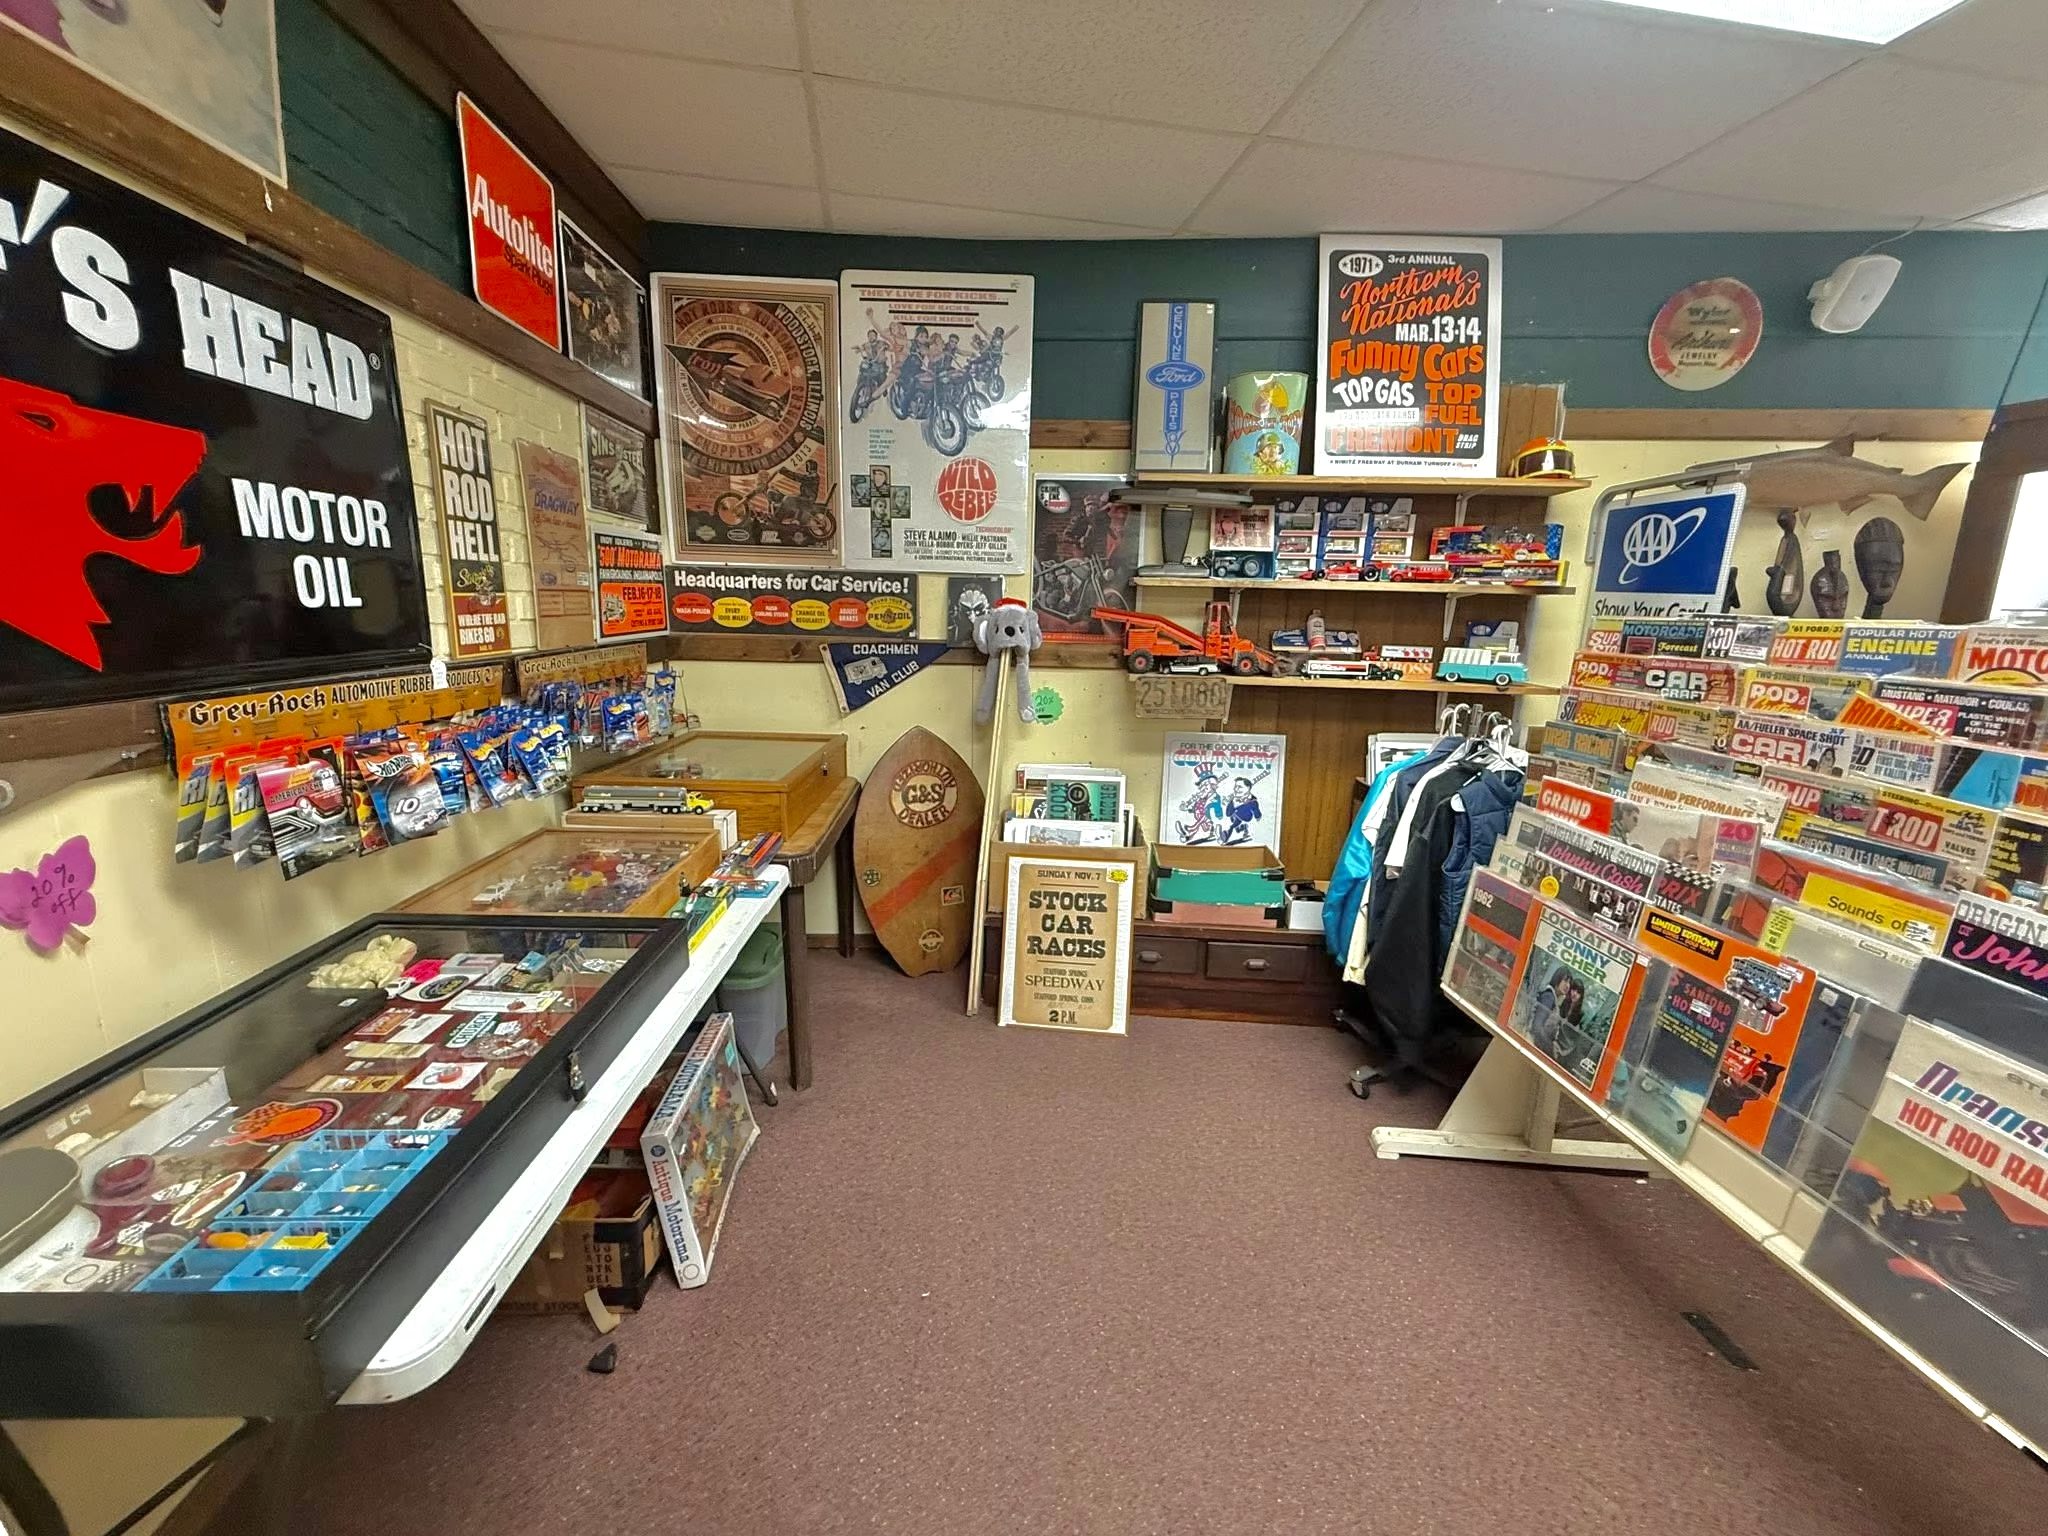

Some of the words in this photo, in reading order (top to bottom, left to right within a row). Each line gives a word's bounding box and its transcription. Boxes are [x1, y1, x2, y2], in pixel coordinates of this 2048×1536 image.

[472, 173, 553, 279] Autolite
[1349, 258, 1374, 273] 1971
[1388, 254, 1406, 264] 3rd
[1407, 254, 1456, 265] ANNUAL
[860, 289, 893, 297] THEY
[896, 290, 925, 298] LIVE
[927, 291, 952, 299] FOR
[1340, 265, 1479, 306] Northern
[1341, 281, 1481, 336] Nationals
[1171, 305, 1183, 361] GENUINE
[1396, 323, 1432, 342] MAR.
[1330, 338, 1420, 381] Funny
[1423, 342, 1484, 381] Cars
[1155, 366, 1197, 383] Ford
[1333, 376, 1374, 407] TOP
[1374, 379, 1415, 407] GAS
[1425, 383, 1482, 403] TOP
[800, 380, 824, 431] ILLINOIS
[1168, 392, 1178, 430] PARTS
[1424, 405, 1482, 426] FUEL
[435, 415, 486, 475] HOT
[1330, 426, 1459, 454] FREMONT
[790, 444, 813, 466] 2013
[939, 459, 997, 490] WILD
[442, 470, 494, 522] ROD
[938, 489, 998, 521] REBELS
[231, 478, 391, 550] MOTOR
[447, 519, 499, 562] HELL
[904, 529, 926, 540] STEVE
[928, 530, 957, 541] ALAIMO
[980, 535, 1008, 543] PASTRANO
[918, 540, 934, 548] VELLA
[956, 541, 974, 549] BYERS
[988, 542, 1008, 550] GILLEN
[1627, 515, 1670, 564] AAA
[618, 547, 662, 569] MOTORAMA
[292, 555, 363, 608] OIL
[674, 570, 782, 591] Headquarters
[786, 576, 808, 591] for
[811, 575, 839, 592] Car
[842, 577, 909, 594] Service!
[867, 612, 912, 622] PENNZOIL
[1594, 600, 1630, 616] Show
[1632, 600, 1665, 616] Your
[460, 628, 483, 645] BIKES
[484, 628, 495, 643] GO
[1850, 628, 1905, 638] POPULAR
[1908, 630, 1934, 639] HOT
[853, 644, 919, 655] COACHMEN
[1658, 642, 1698, 652] Forecast
[1770, 639, 1803, 658] HOT
[1844, 653, 1891, 661] ANNUAL
[1847, 638, 1939, 656] ENGINE
[866, 679, 890, 698] VAN
[891, 661, 920, 683] CLUB
[1578, 661, 1609, 676] ROD
[1645, 669, 1708, 691] CAR
[190, 688, 326, 727] Grey-Rock
[331, 681, 397, 704] AUTOMOTIVE
[1749, 683, 1800, 703] ROD
[1881, 688, 1925, 702] MUSTANG
[1933, 693, 1979, 707] MATADOR
[1958, 712, 1993, 722] PLASTIC
[1969, 720, 1982, 728] OF
[1984, 721, 2001, 730] THE
[1737, 719, 1786, 736] AA/FUELER
[1819, 732, 1845, 746] SHOT
[1180, 742, 1196, 750] FOR
[1215, 743, 1239, 751] GOOD
[1731, 733, 1803, 761] CAR
[270, 785, 308, 804] AMERICAN
[902, 783, 944, 804] G&S
[1631, 780, 1677, 800] COMMAND
[395, 797, 420, 814] 10
[1542, 789, 1591, 817] GRAND
[899, 805, 950, 826] DEALER
[1720, 821, 1756, 842] 20
[1886, 811, 1939, 848] ROD
[1592, 840, 1614, 863] SUN
[1617, 849, 1657, 876] SOUND
[1945, 840, 1976, 857] VALVES
[1548, 841, 1598, 877] Johnny
[1600, 863, 1644, 894] Cash
[1873, 853, 1897, 872] RACE
[31, 863, 76, 908] 20%
[1037, 870, 1071, 879] SUNDAY
[1074, 871, 1095, 880] NOV.
[1096, 872, 1101, 880] 7
[1525, 852, 1570, 884] ROXY
[1573, 876, 1638, 915] MUSIC
[1029, 890, 1108, 913] STOCK
[1473, 887, 1494, 909] 1962
[1652, 895, 1682, 915] STATES
[1041, 914, 1094, 935] CAR
[1828, 895, 1885, 925] Sounds
[1890, 919, 1908, 932] of
[1542, 906, 1582, 938] LOOK
[1583, 928, 1604, 946] AT
[1610, 946, 1635, 966] US
[1651, 916, 1681, 935] LIMITED
[1681, 926, 1719, 949] EDITION!
[1026, 936, 1106, 959] RACES
[1552, 930, 1611, 968] SONNY
[1547, 943, 1557, 954] &
[1560, 950, 1608, 983] CHER
[1025, 975, 1105, 992] SPEEDWAY
[1049, 1010, 1059, 1023] 2
[1061, 1011, 1078, 1024] P.M.
[453, 1013, 493, 1048] CHURCH
[654, 1056, 706, 1121] MOTORAMA
[1898, 1096, 1948, 1139] HOT
[1945, 1122, 2001, 1169] ROD
[652, 1160, 673, 1203] Antique
[665, 1200, 689, 1265] Motorama
